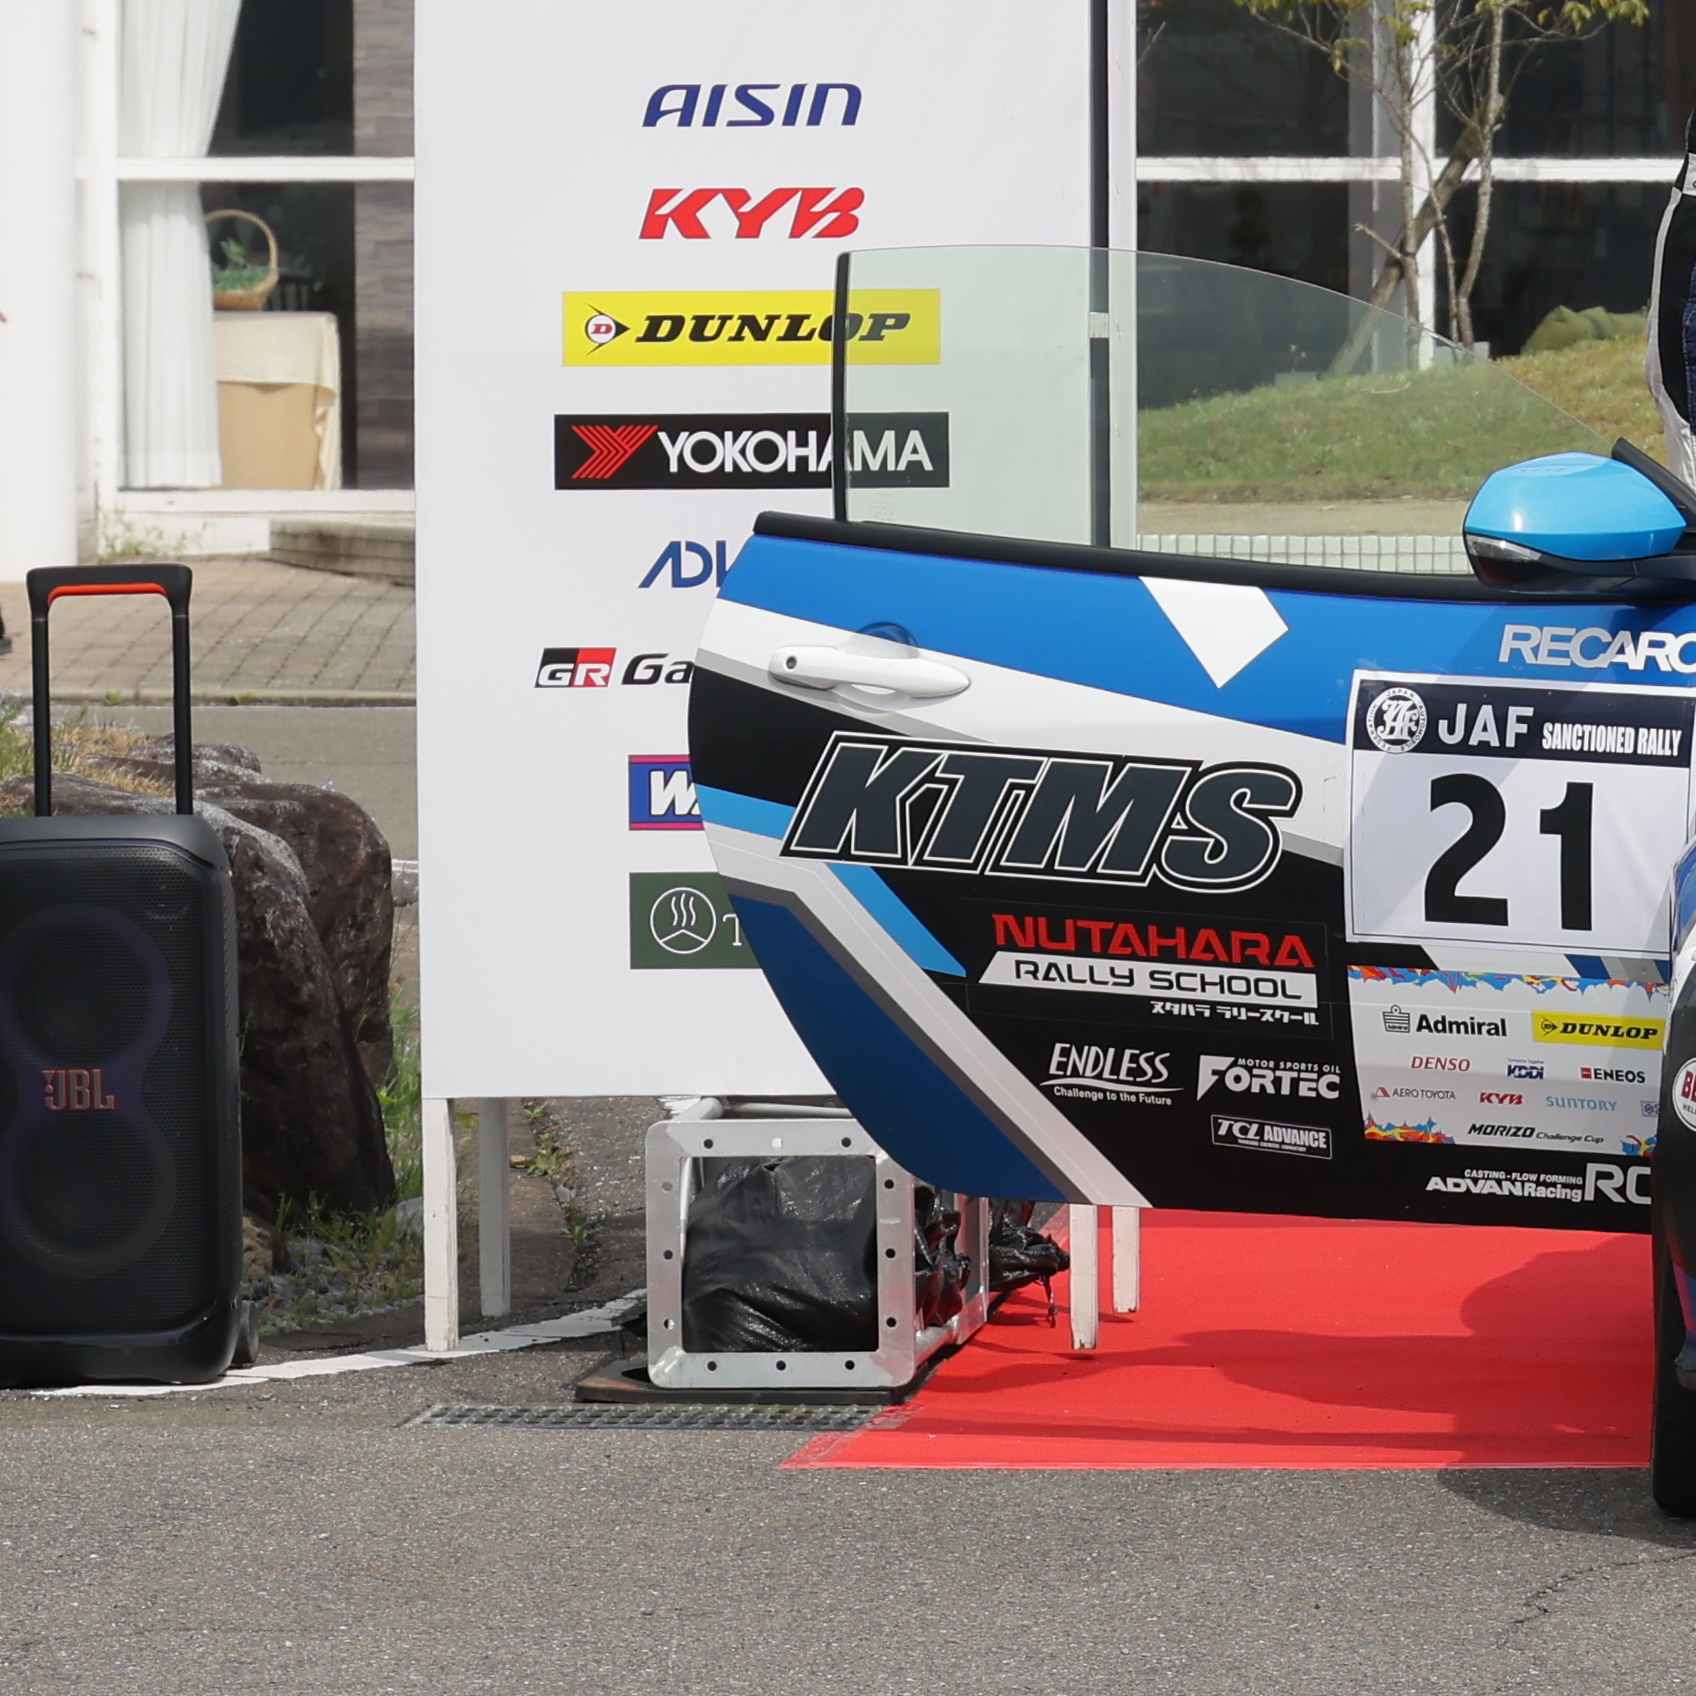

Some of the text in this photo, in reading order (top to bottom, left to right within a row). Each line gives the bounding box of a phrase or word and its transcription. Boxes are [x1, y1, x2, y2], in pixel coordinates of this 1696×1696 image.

[642, 83, 862, 127] AISIN
[638, 187, 865, 239] KYB
[634, 312, 911, 343] DUNLOP
[1438, 703, 1534, 748] JAF
[1541, 721, 1636, 757] SANCTIONED
[1637, 727, 1682, 757] RALLY
[783, 735, 1300, 891] KTMS
[1424, 772, 1594, 932] 21
[992, 913, 1316, 968] NUTAHARA
[1014, 959, 1304, 1000] RALLY SCHOOL
[1416, 1013, 1508, 1037] Admiral
[1559, 1022, 1659, 1040] DUNLOP
[1049, 1042, 1170, 1083] ENDLESS
[1196, 1055, 1341, 1100] FORTEC
[1237, 1058, 1341, 1074] MOTOR SPORTS OIL
[1411, 1056, 1471, 1072] DENSO
[1507, 1064, 1544, 1080] KDDI
[1593, 1068, 1646, 1083] ENEOS
[42, 1067, 115, 1111] JBL
[1053, 1086, 1173, 1106] Challenge the Future
[1479, 1092, 1523, 1105] KYB
[1217, 1118, 1260, 1140] TCL
[1263, 1125, 1328, 1149] ADVANCE
[1467, 1123, 1604, 1145] MORIZO Challenge Cup
[1540, 1173, 1583, 1185] FORMING
